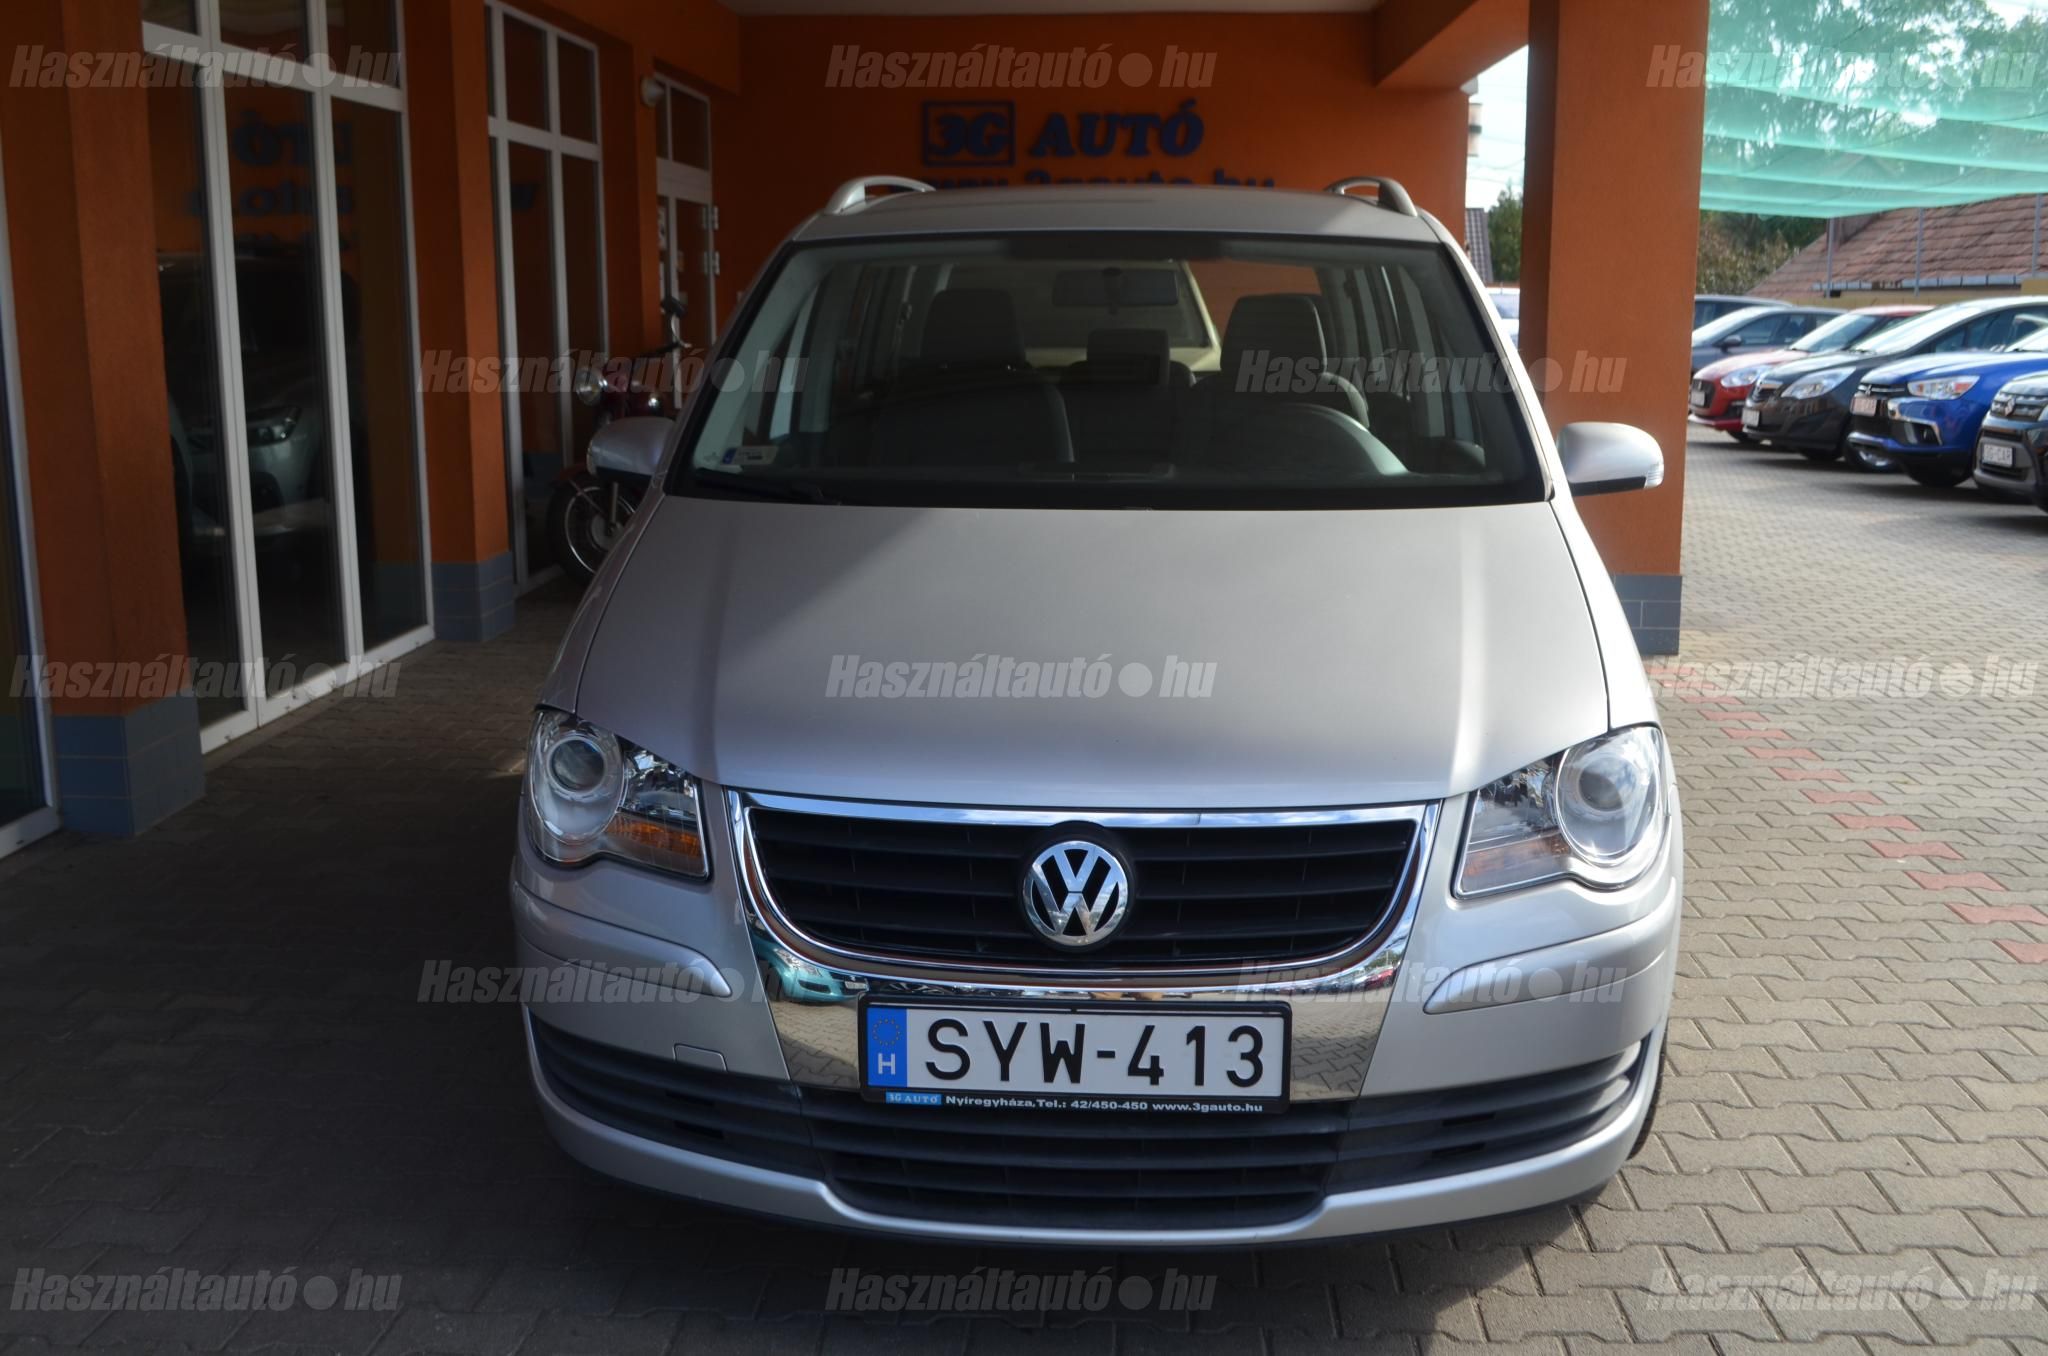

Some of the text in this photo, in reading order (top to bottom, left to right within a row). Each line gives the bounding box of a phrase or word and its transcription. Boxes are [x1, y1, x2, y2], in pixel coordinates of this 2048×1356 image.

[927, 98, 1205, 158] 3G AUTÓ
[877, 1053, 896, 1075] H
[924, 1018, 1264, 1088] SYW-413
[1070, 1100, 1148, 1110] 42/450-450
[1152, 1102, 1263, 1113] www.3gauto.hu
